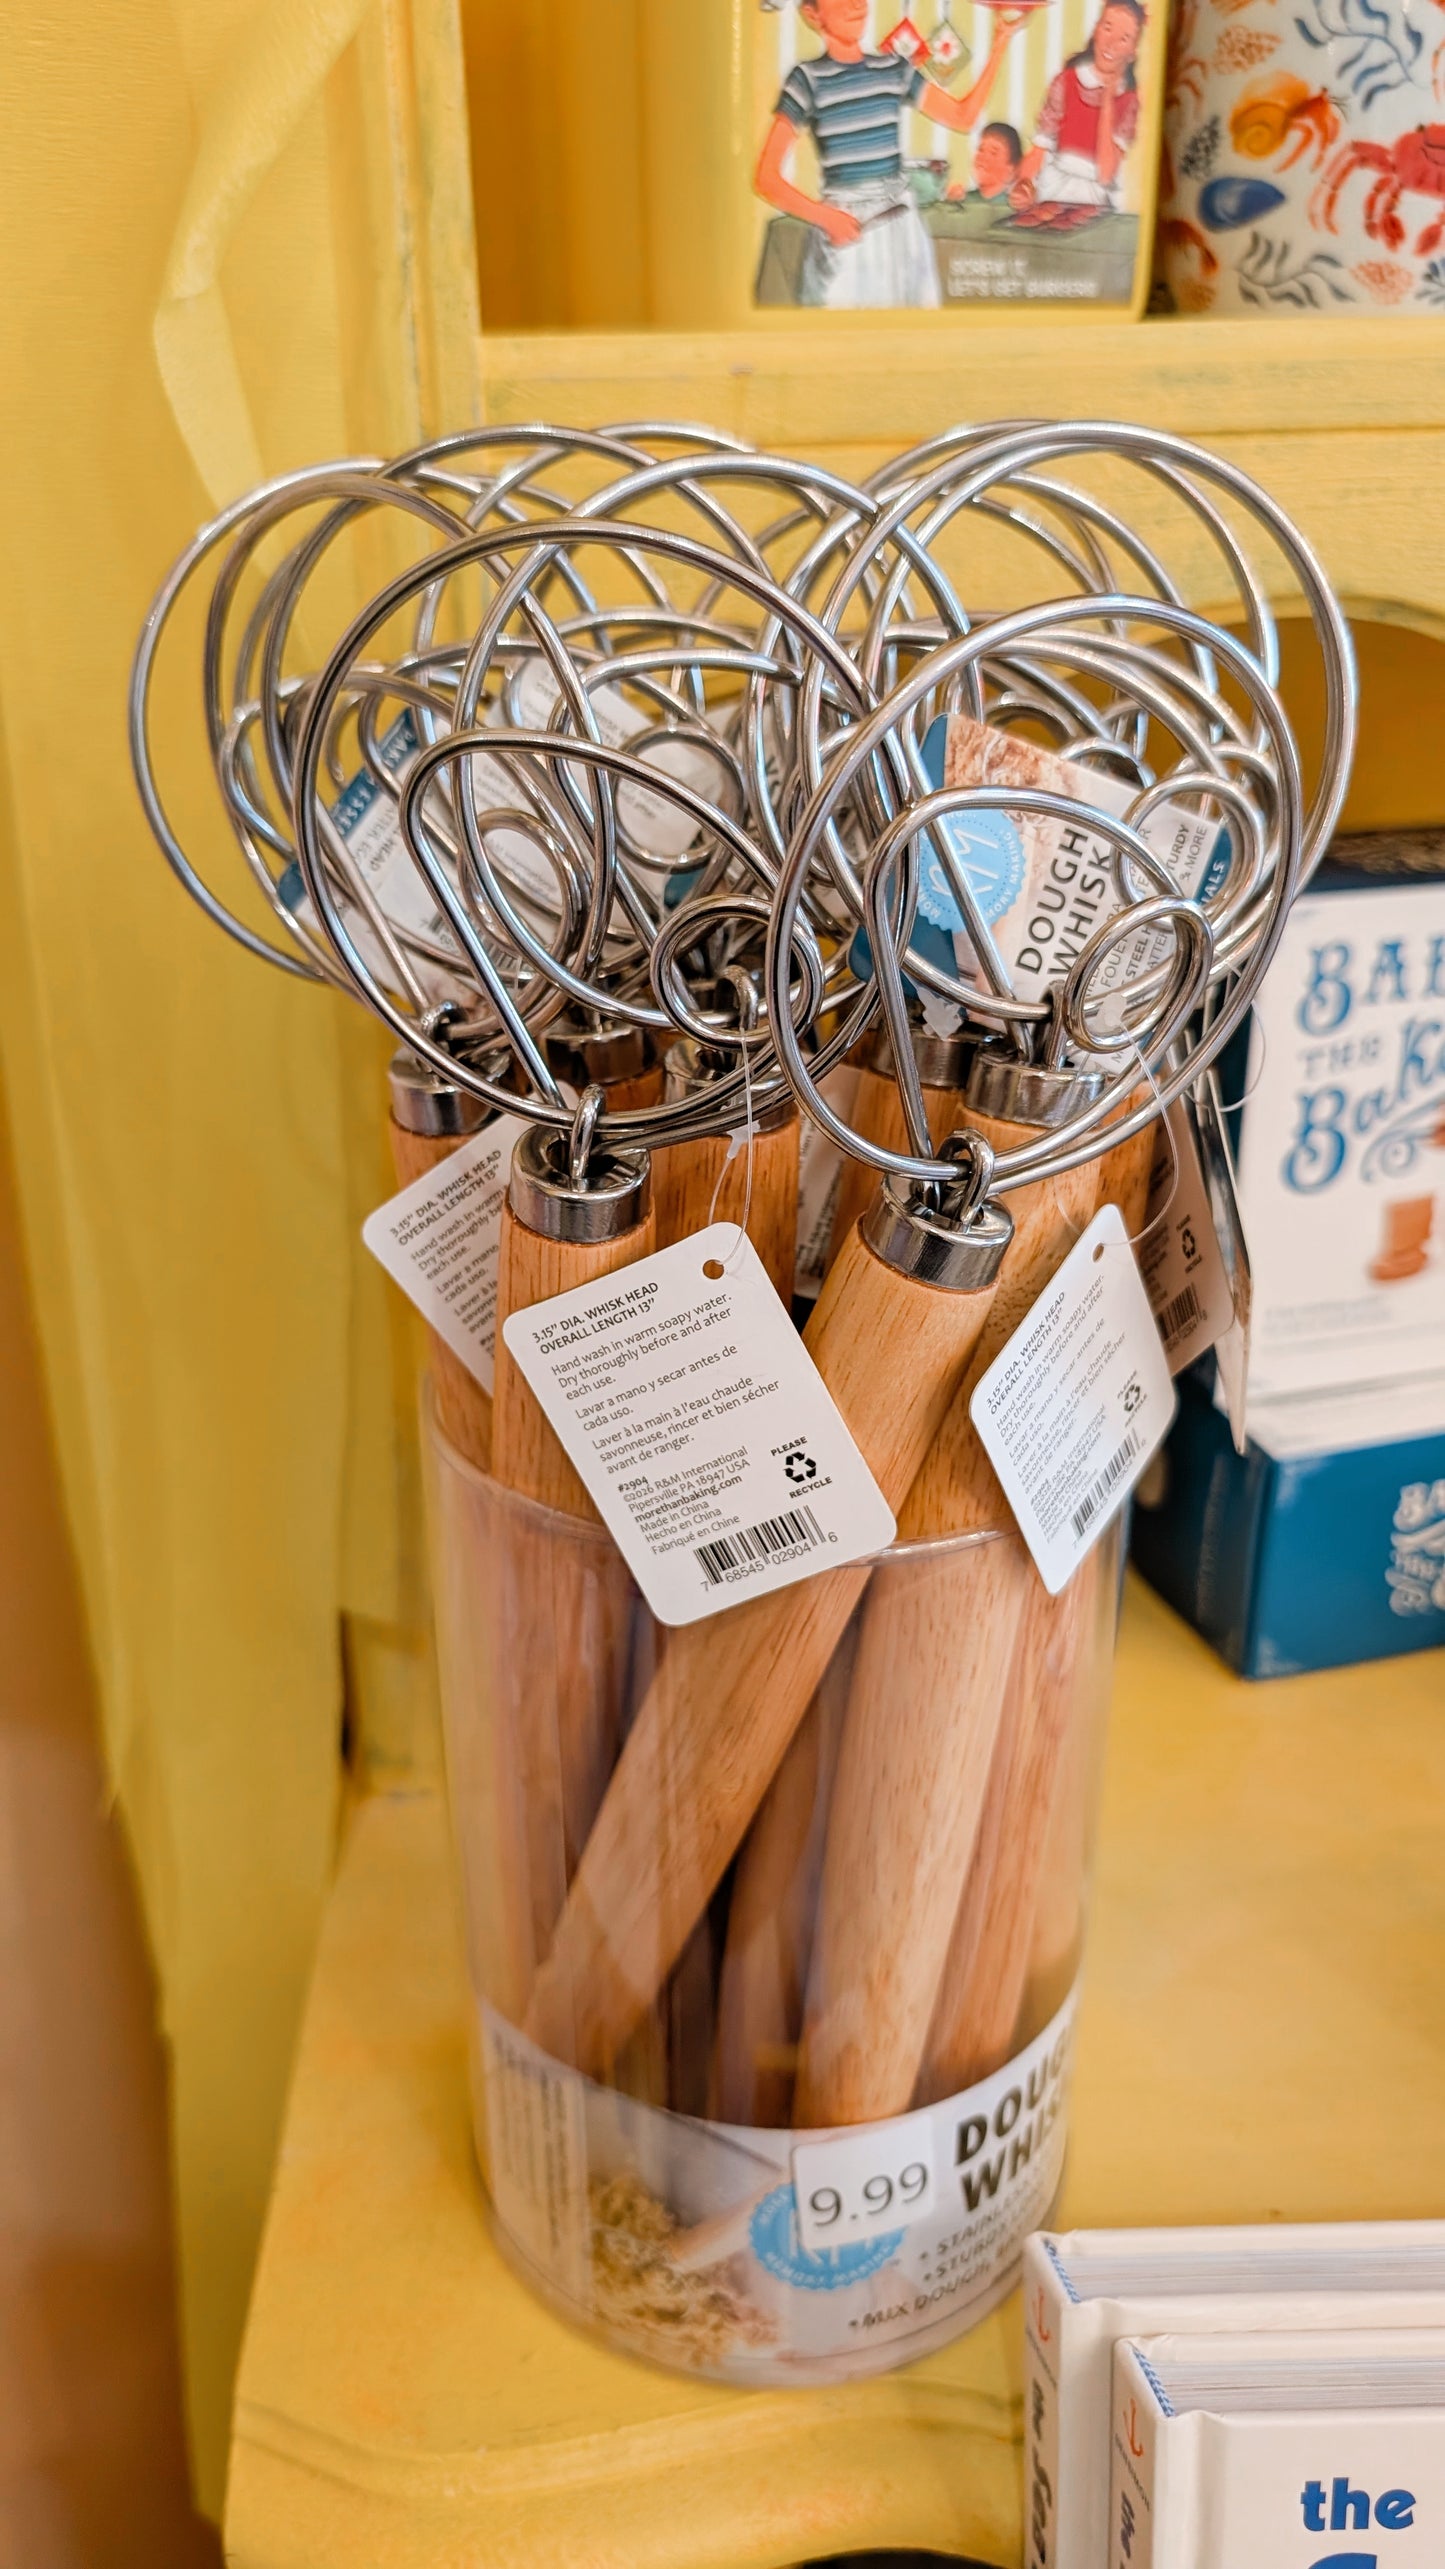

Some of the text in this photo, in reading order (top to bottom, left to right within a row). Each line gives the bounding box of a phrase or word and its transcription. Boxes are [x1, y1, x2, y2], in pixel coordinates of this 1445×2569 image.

[1164, 823, 1190, 870] TURDY
[1184, 826, 1207, 868] MORE
[1015, 828, 1088, 976] DOUGH
[1049, 846, 1112, 976] WHISK
[1126, 936, 1150, 978] STEEL
[437, 1171, 474, 1200] WHISK
[472, 1150, 501, 1175] HEAD
[398, 1209, 446, 1245] OVERALL
[444, 1176, 485, 1211] LENGTH
[540, 1328, 592, 1355] OVERALL
[591, 1307, 638, 1333] LENGTH
[559, 1315, 585, 1331] DIA.
[584, 1296, 625, 1320] WHISK
[624, 1282, 659, 1303] HEAD
[551, 1293, 732, 1376] Hand wash in warm soapy water.
[558, 1307, 731, 1389] Dry thoroughly before and after
[996, 1274, 1105, 1430] Hand wash in warm soapy water.
[1004, 1360, 1021, 1381] DIA.
[1020, 1321, 1045, 1357] WHISK
[1044, 1291, 1065, 1323] HEAD
[575, 1345, 738, 1419] Lavar a mano y secar antes de
[990, 1368, 1024, 1415] OVERALL
[1023, 1324, 1052, 1367] LENGTH
[999, 1286, 1103, 1438] Dry thoroughly before and after
[566, 1376, 617, 1401] each use.
[1008, 1317, 1105, 1459] Lavar a mano y secar antes de
[1017, 1449, 1037, 1479] Laver
[1049, 1406, 1066, 1433] main
[1087, 1340, 1112, 1376] chaude
[583, 1406, 634, 1431] cada uso.
[591, 1431, 622, 1450] Laver
[623, 1426, 633, 1438] à
[631, 1423, 645, 1434] la
[644, 1412, 673, 1429] main
[672, 1406, 682, 1417] à
[711, 1377, 753, 1401] chaude
[599, 1380, 779, 1462] savonneuse, rincer et bien sécher
[1004, 1402, 1036, 1446] each use.
[606, 1434, 695, 1474] avant de ranger.
[654, 1473, 682, 1490] R&M
[681, 1445, 748, 1480] International
[770, 1436, 808, 1457] PLEASE
[1012, 1422, 1045, 1467] cada uso.
[617, 1476, 649, 1493] #2904
[628, 1458, 751, 1513] Pipersville PA 18947 USA
[634, 1476, 742, 1523] morethanbaking.com
[789, 1476, 832, 1499] RECYCLE
[639, 1501, 710, 1533] Made in China
[644, 1508, 722, 1543] Hecho en China
[651, 1515, 741, 1555] Fabriqué en Chine
[700, 1531, 839, 1593] 7 68545 02904 6
[810, 2162, 929, 2228] 9.99
[1301, 2477, 1417, 2532] the
